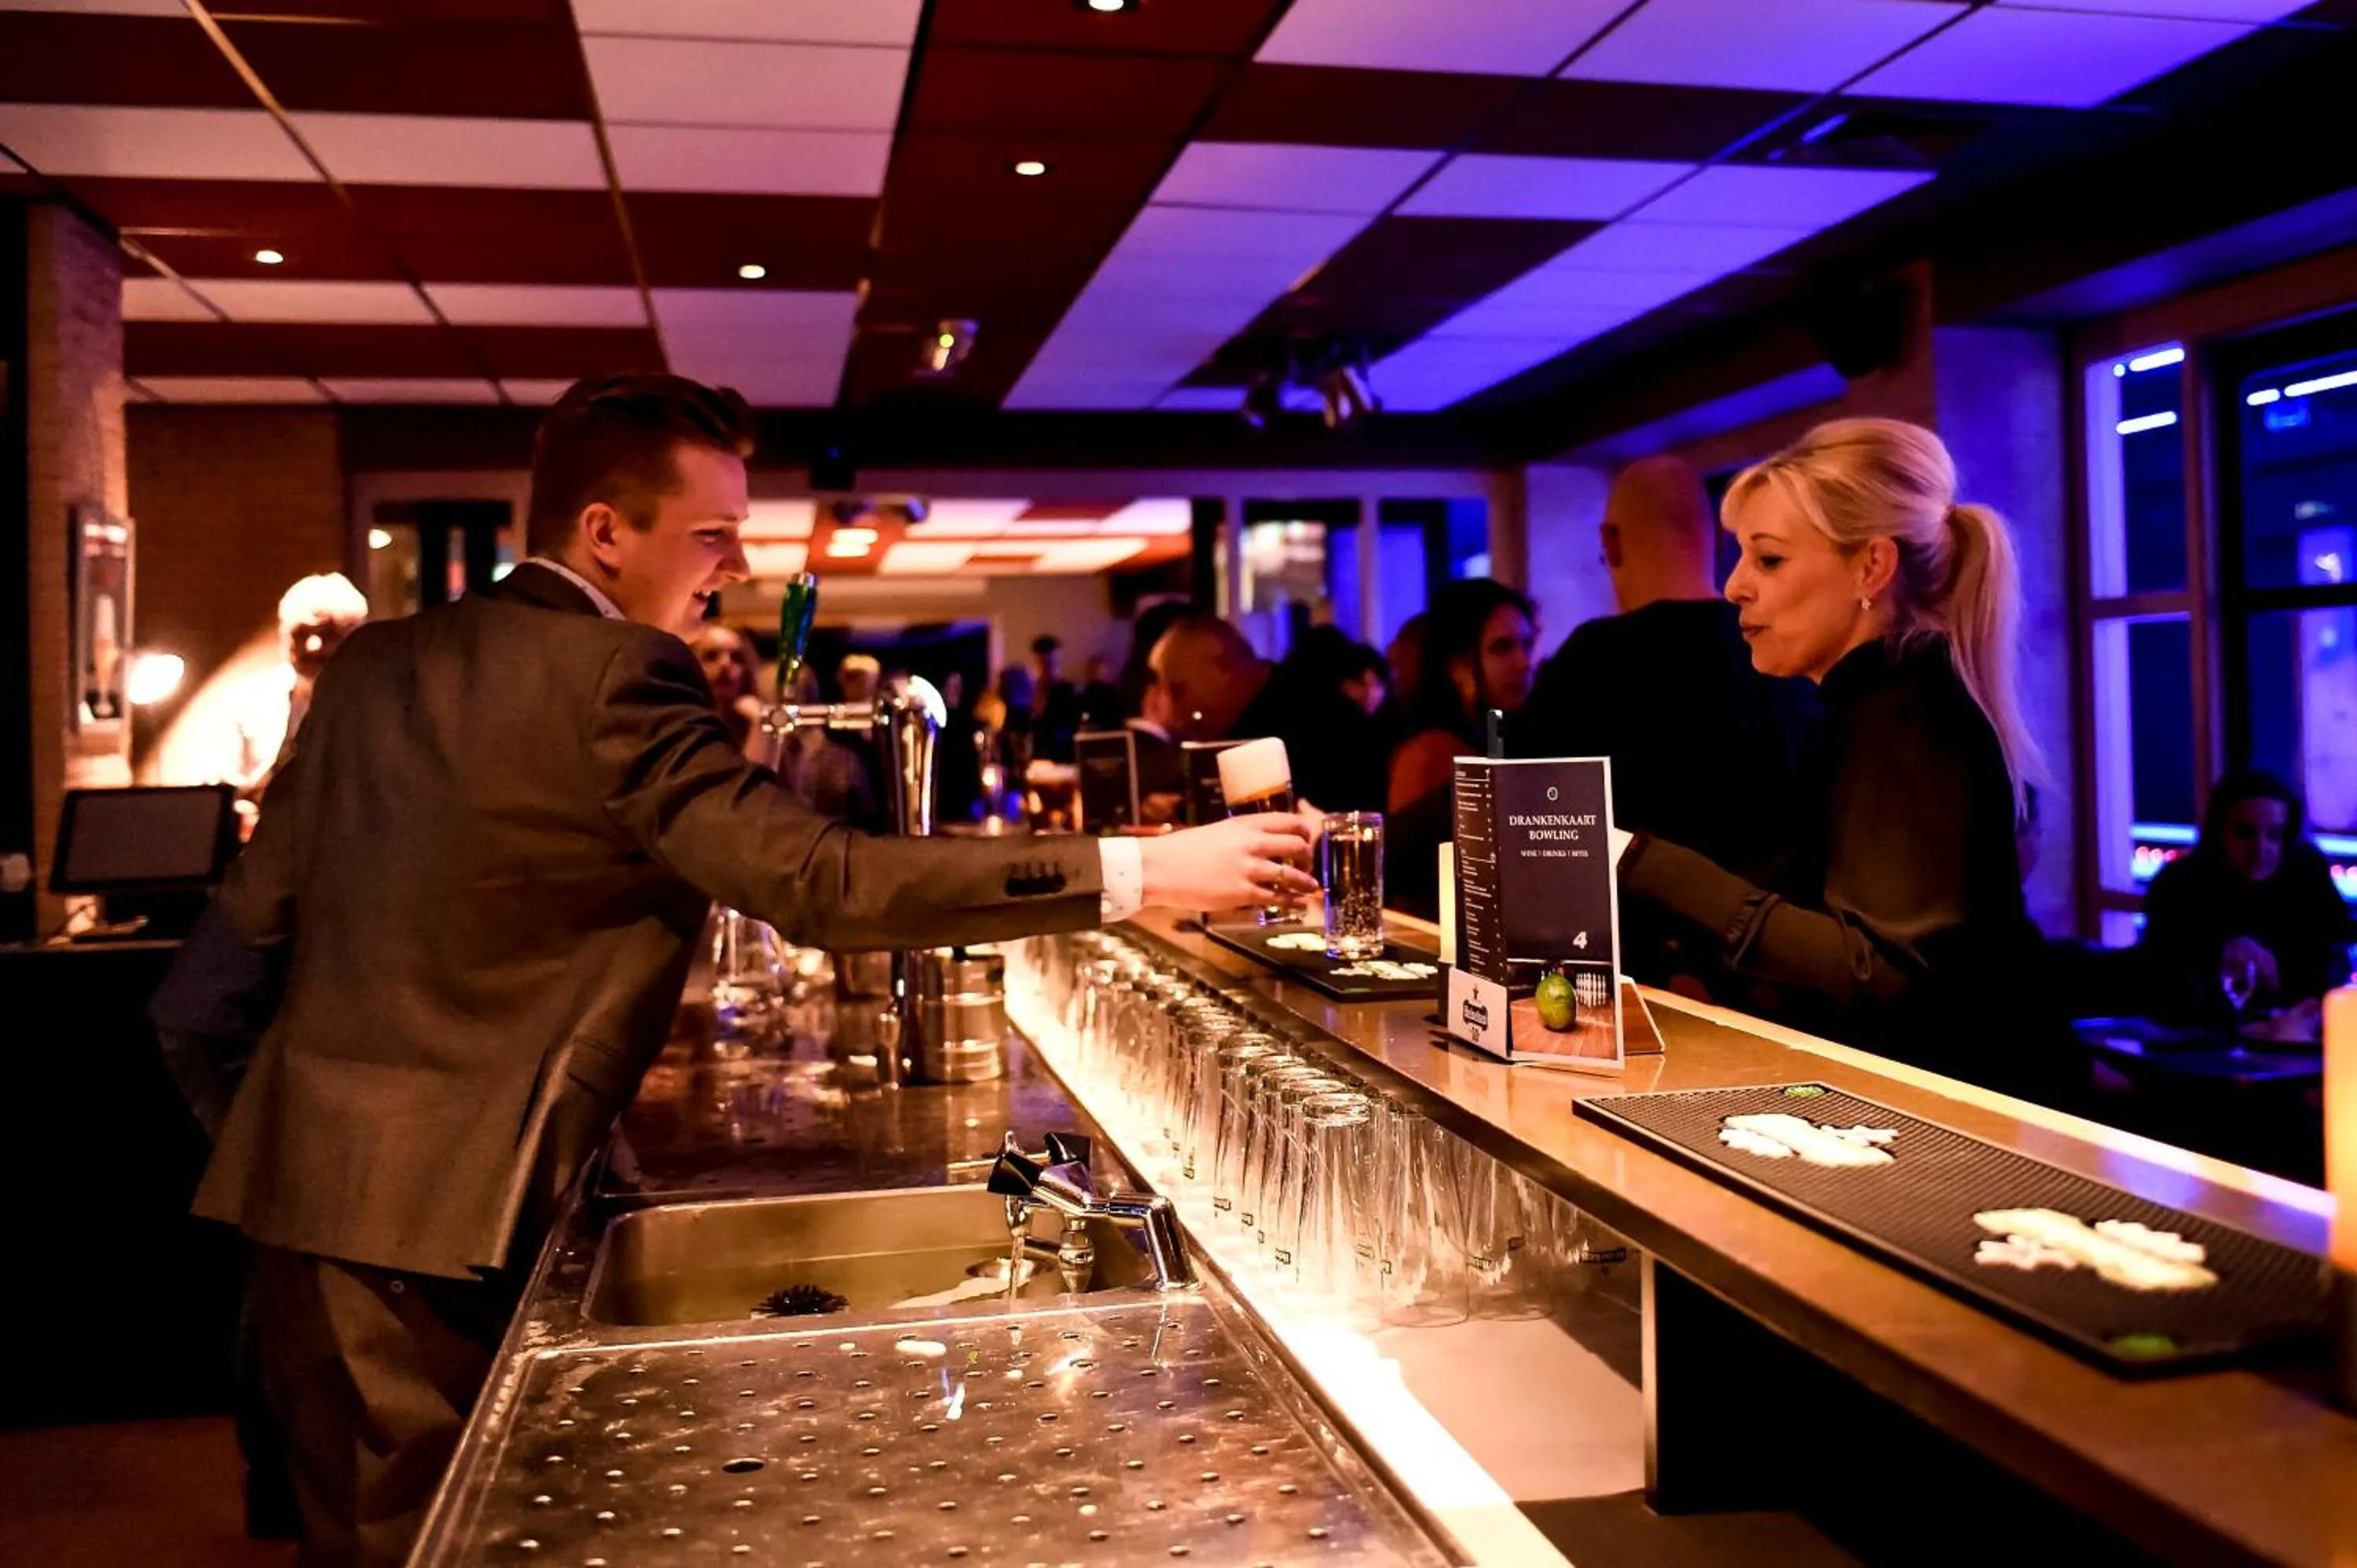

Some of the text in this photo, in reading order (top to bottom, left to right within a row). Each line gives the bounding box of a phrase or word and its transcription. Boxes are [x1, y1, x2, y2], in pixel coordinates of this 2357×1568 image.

[1509, 815, 1596, 826] DRANKENKAART
[1529, 829, 1579, 840] BOWLING
[1573, 931, 1588, 949] 4
